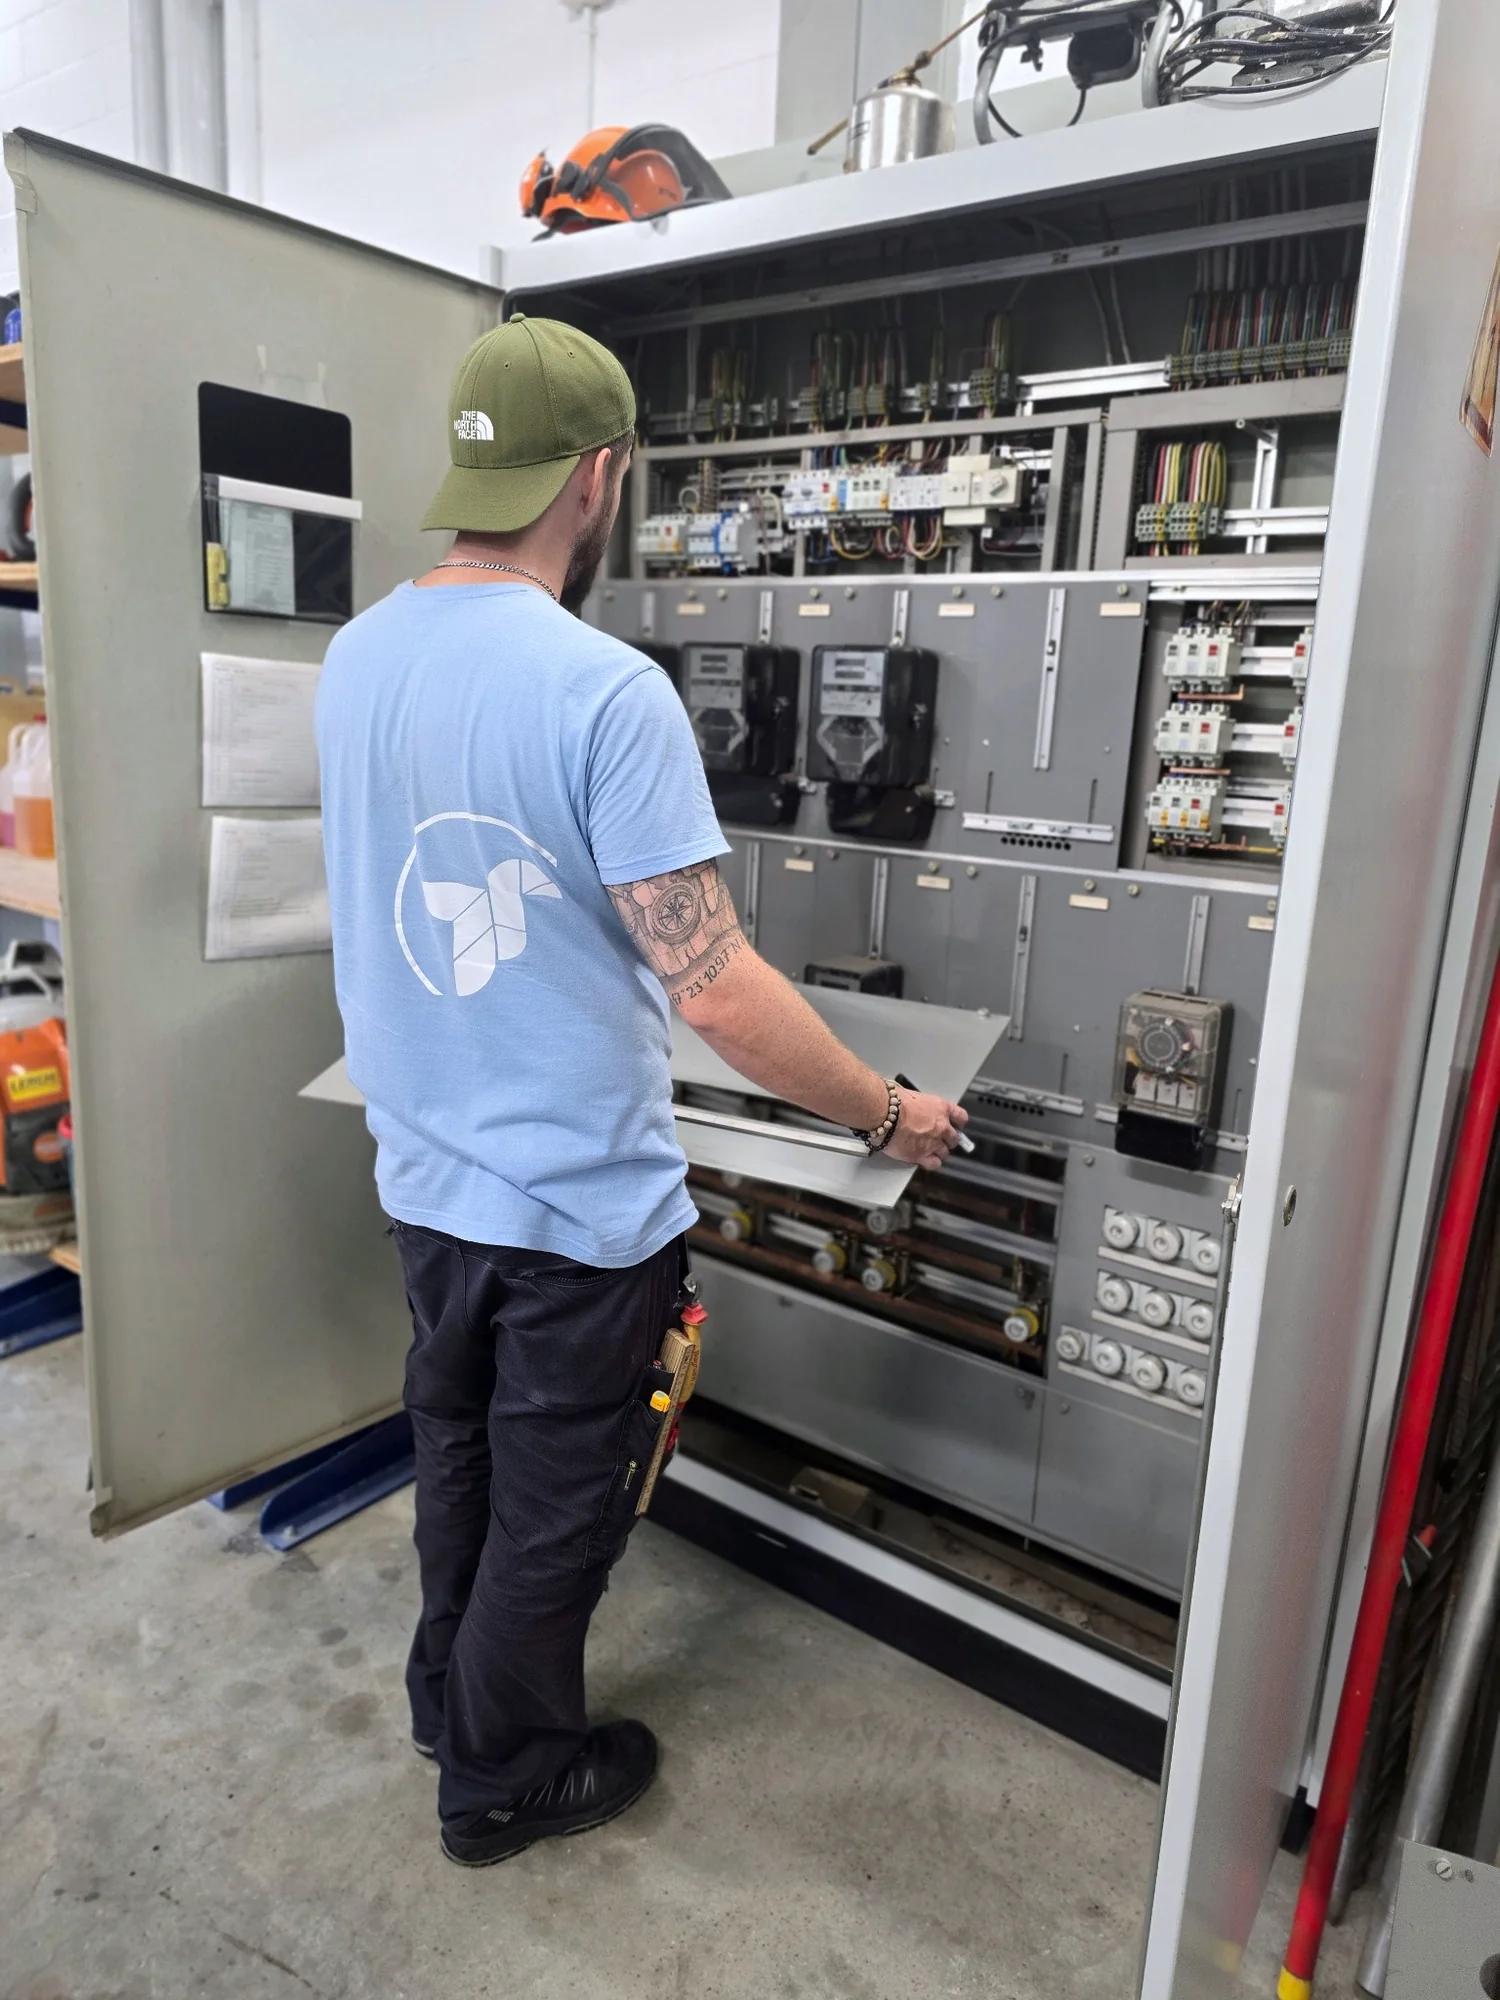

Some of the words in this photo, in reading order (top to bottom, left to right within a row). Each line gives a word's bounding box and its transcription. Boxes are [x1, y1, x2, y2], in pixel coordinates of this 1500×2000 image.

[461, 411, 477, 420] THE
[453, 420, 477, 430] NORTH
[458, 430, 477, 440] FACE
